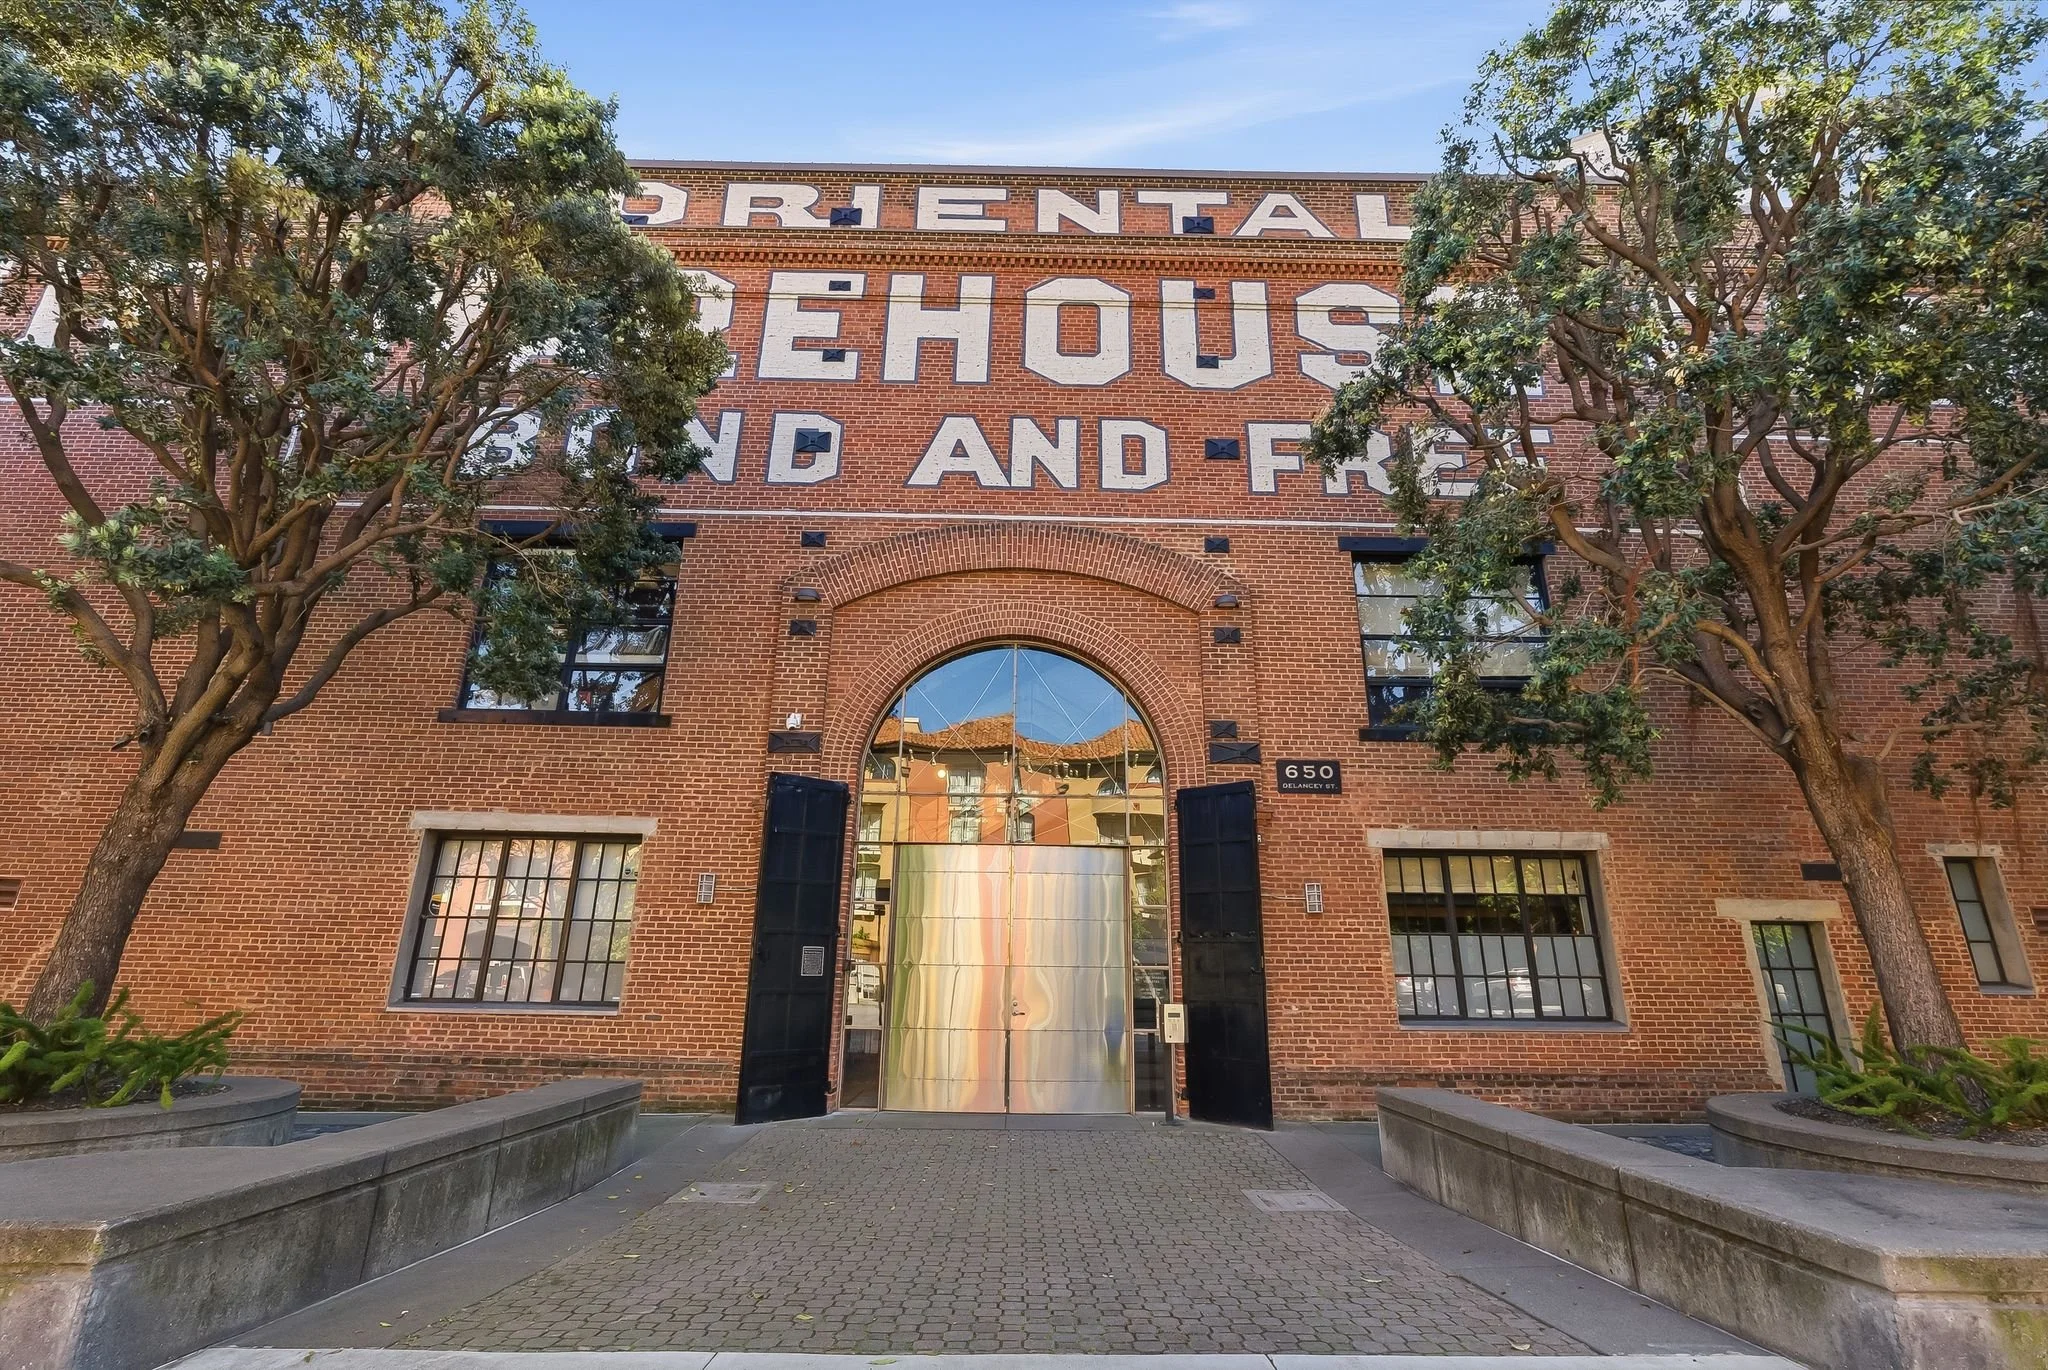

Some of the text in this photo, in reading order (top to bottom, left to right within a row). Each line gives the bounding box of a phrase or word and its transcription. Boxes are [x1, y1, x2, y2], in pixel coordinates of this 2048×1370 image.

[609, 180, 1416, 240] ORIENTAL
[904, 413, 1170, 494] AND
[1285, 764, 1333, 779] 650
